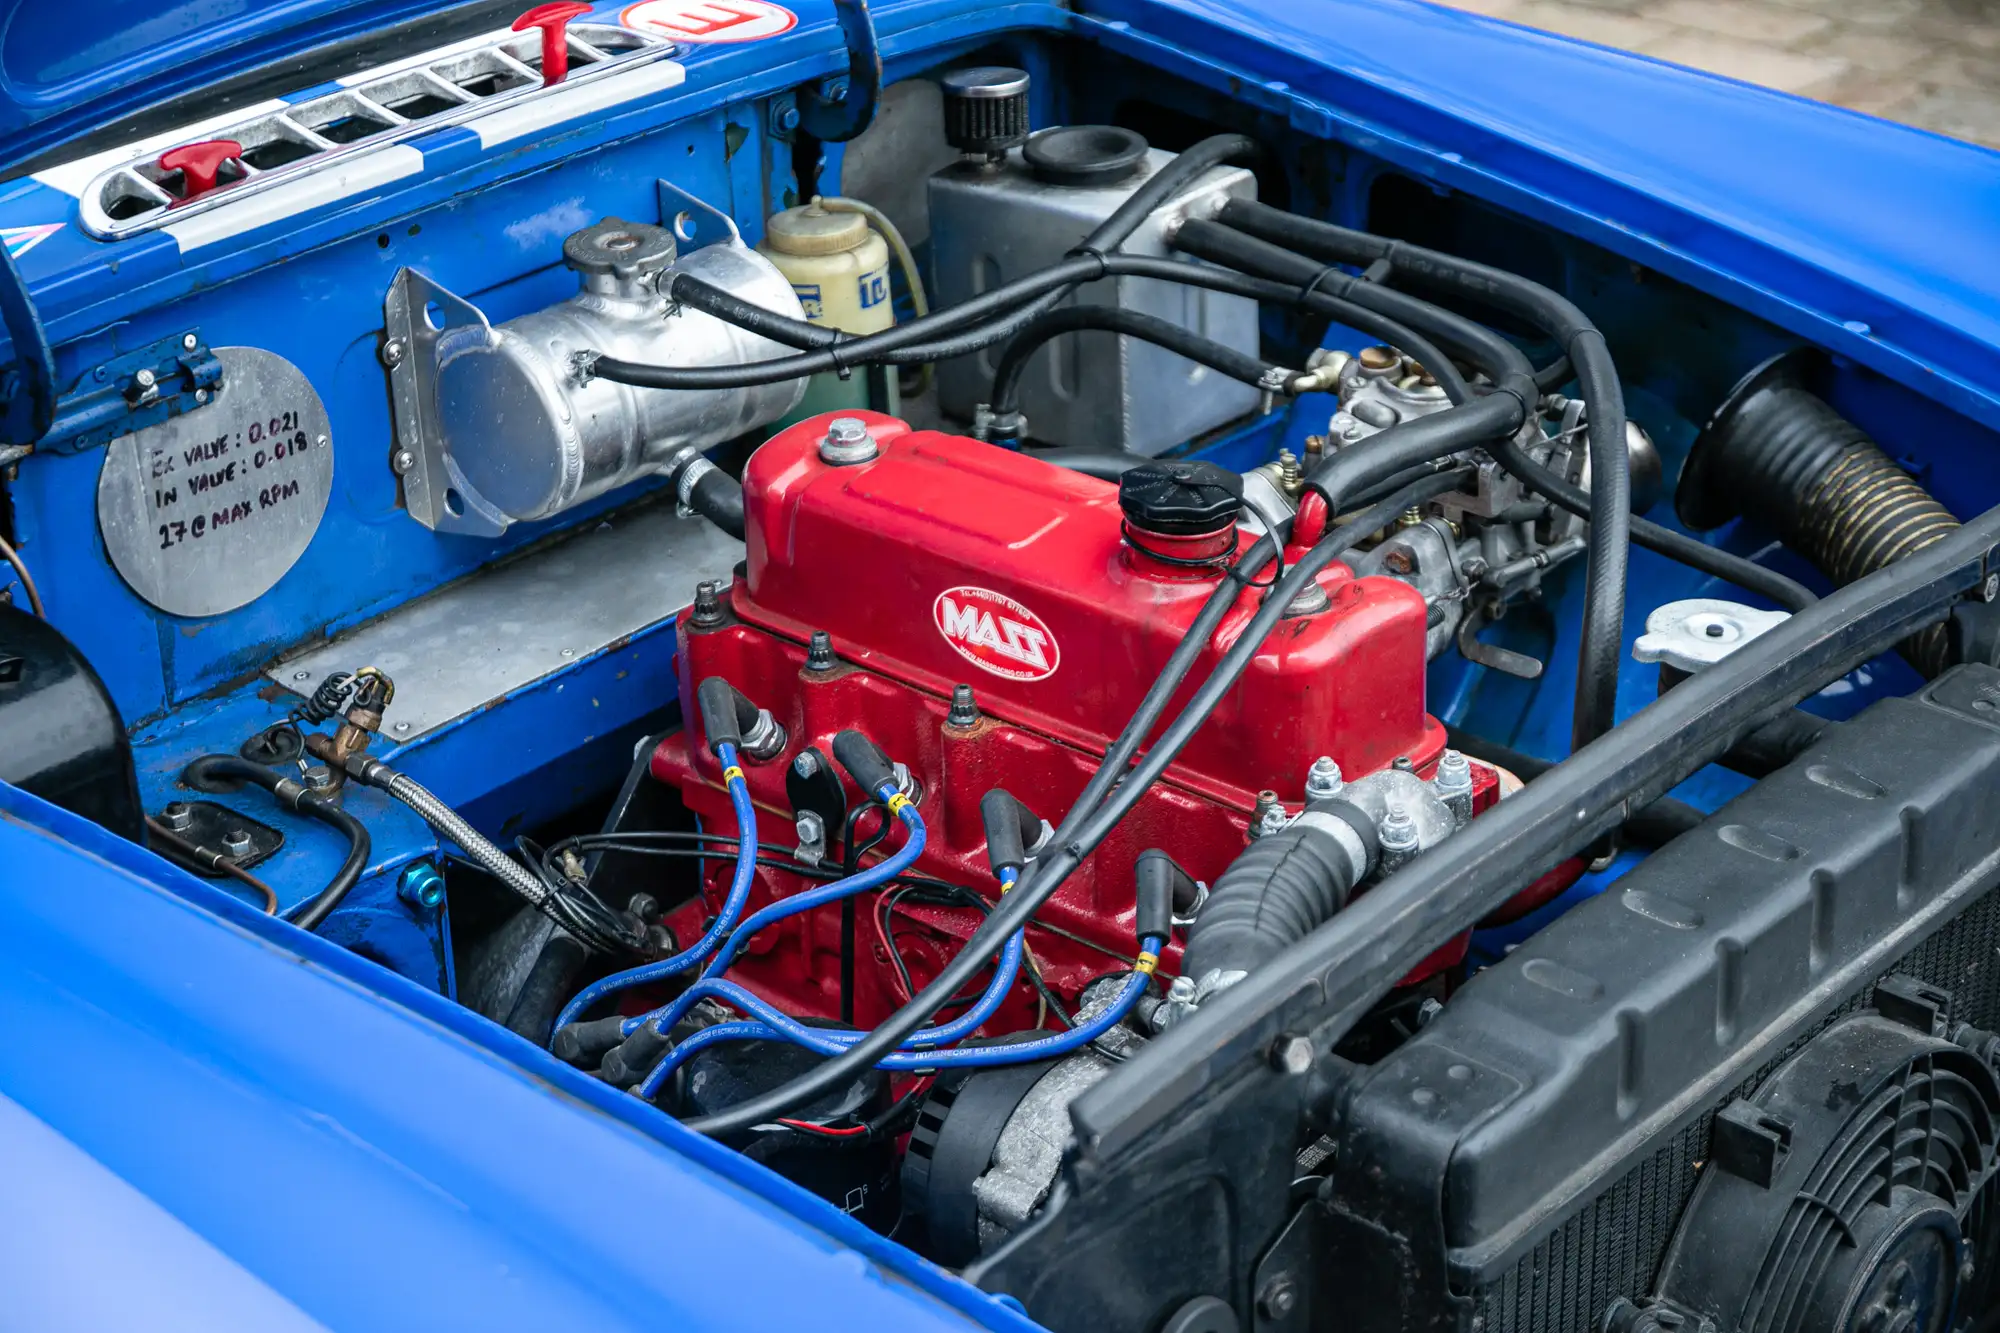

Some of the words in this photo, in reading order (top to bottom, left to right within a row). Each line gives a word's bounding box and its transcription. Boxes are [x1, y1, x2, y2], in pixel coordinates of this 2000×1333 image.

[151, 450, 175, 479] EX
[248, 411, 299, 443] 0.021
[156, 487, 177, 508] IN
[254, 431, 308, 469] 0.018
[211, 501, 252, 530] MAX
[259, 480, 300, 509] RPM
[942, 596, 1051, 672] MASS
[915, 1047, 972, 1060] MAGNECOR
[1107, 986, 1131, 1011] CABLE
